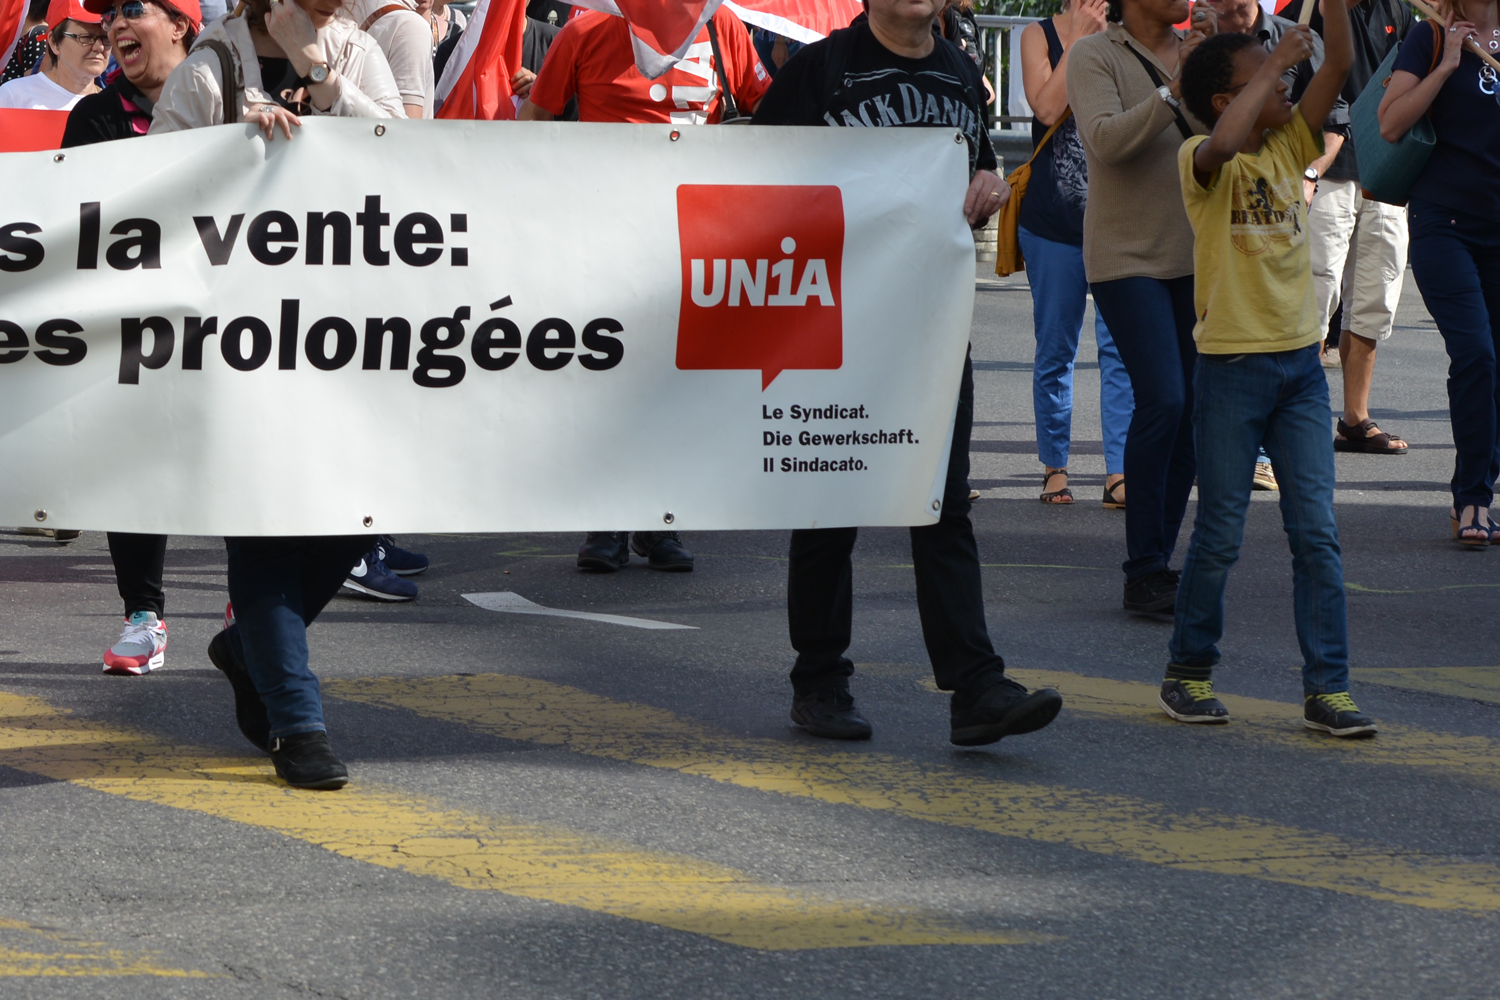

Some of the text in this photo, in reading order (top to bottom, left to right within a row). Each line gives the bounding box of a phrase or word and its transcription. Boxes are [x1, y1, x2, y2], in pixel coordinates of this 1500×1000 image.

[75, 200, 162, 271] la
[192, 194, 469, 268] vente:
[117, 294, 626, 388] prolongées
[762, 404, 870, 423] Le Syndicat.
[762, 428, 920, 447] Die Gewerkschaft.
[780, 456, 869, 473] Sindacato.
